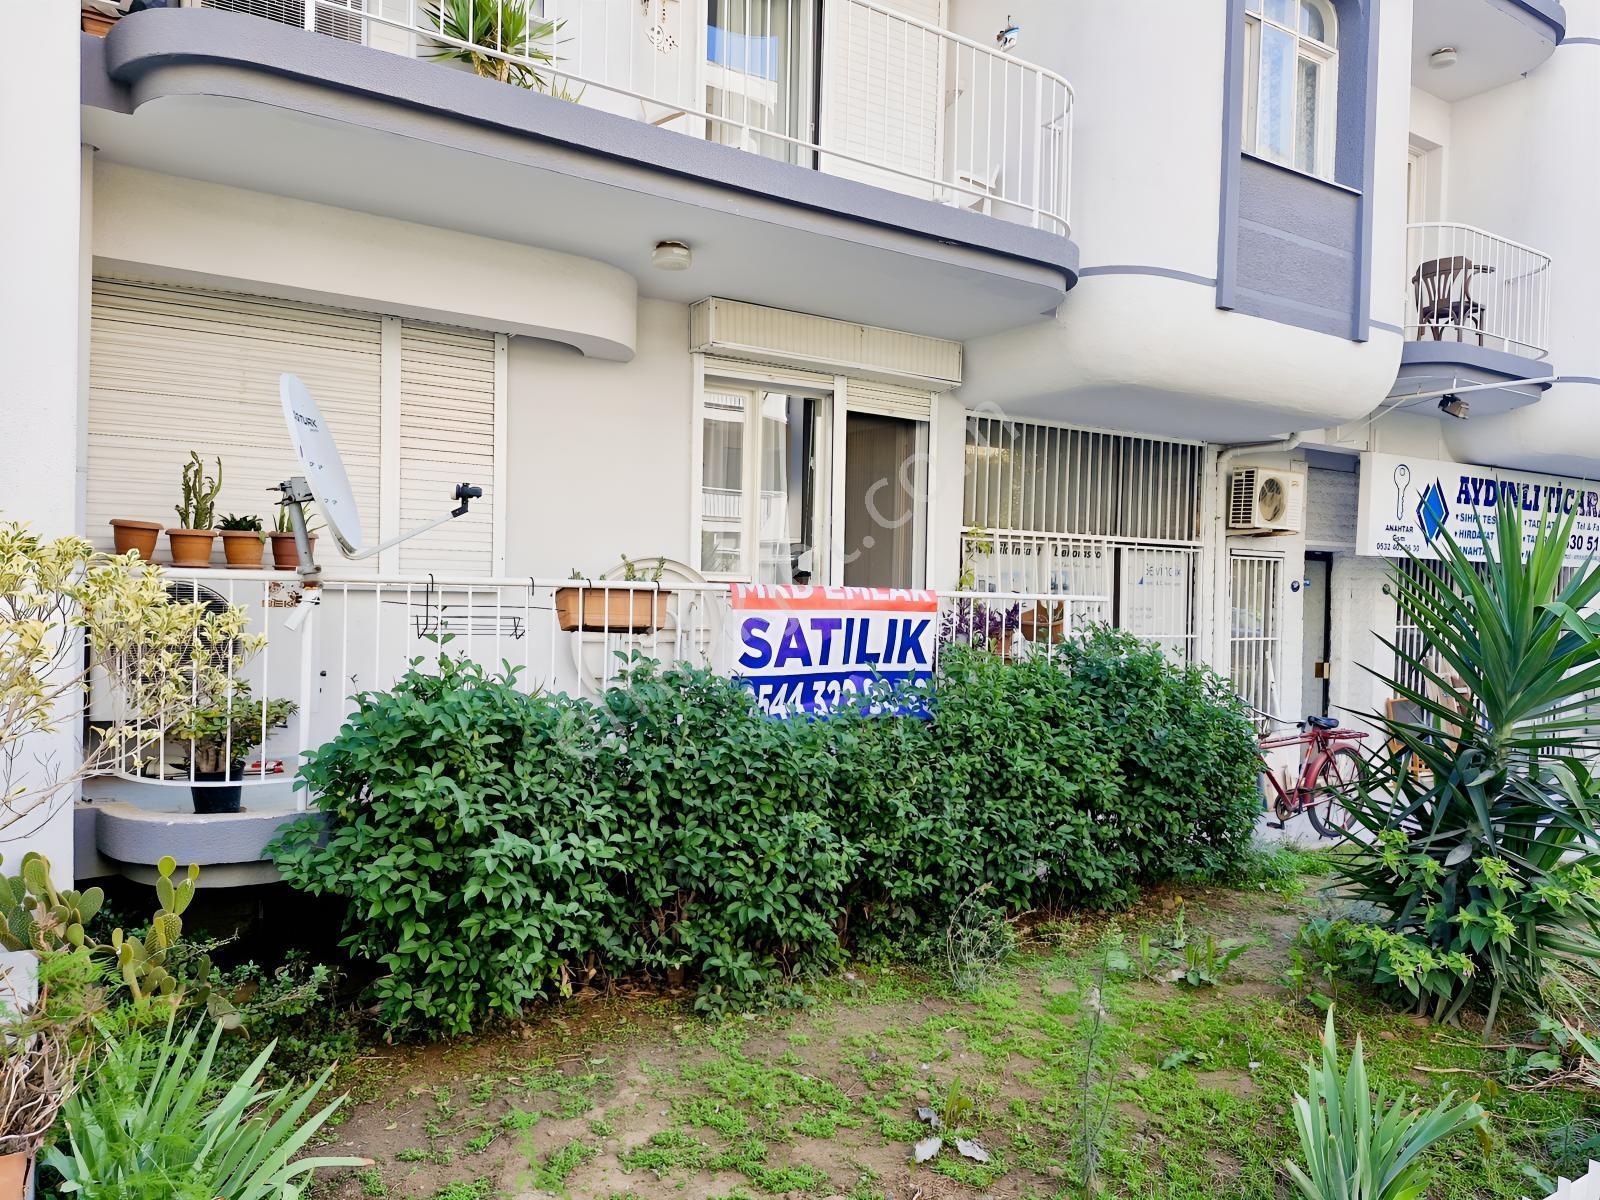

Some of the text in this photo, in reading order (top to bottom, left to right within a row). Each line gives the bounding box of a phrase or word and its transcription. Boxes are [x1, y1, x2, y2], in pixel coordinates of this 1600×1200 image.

[1543, 481, 1600, 518] TİCAR
[1385, 524, 1414, 533] ANAHTAR
[738, 616, 931, 669] SATILIK
